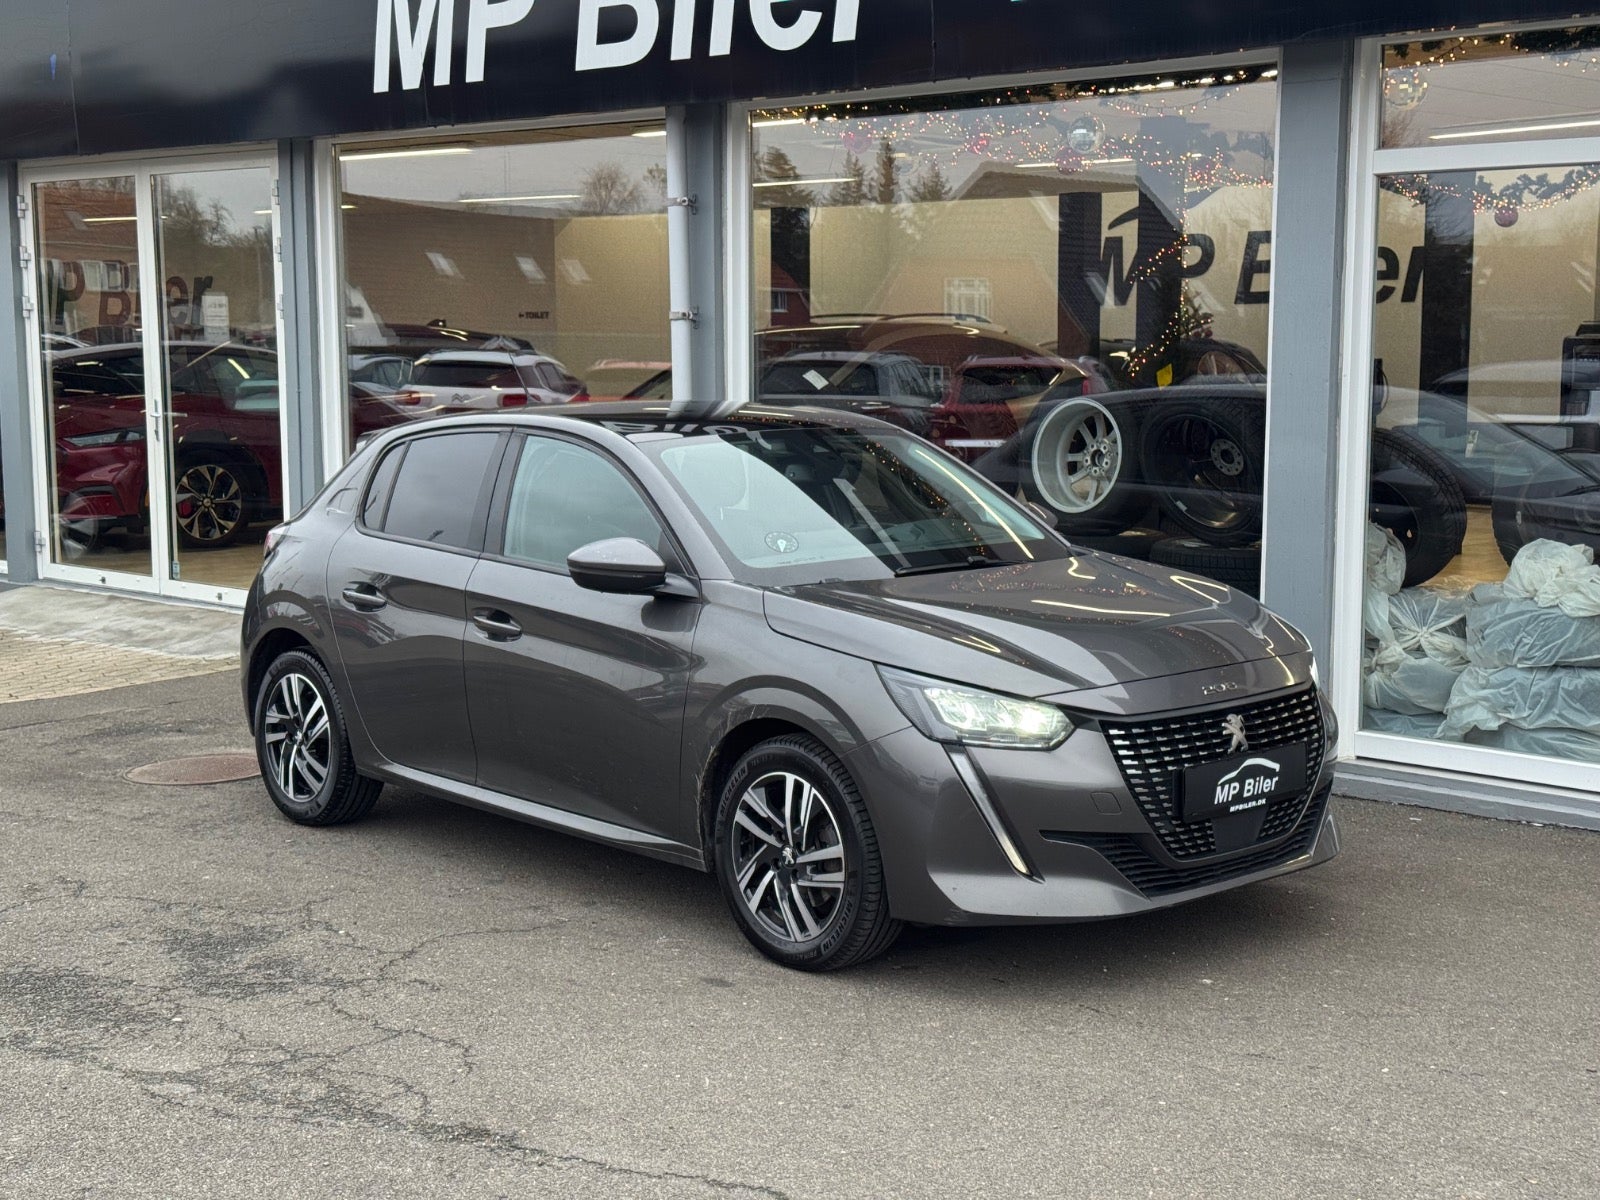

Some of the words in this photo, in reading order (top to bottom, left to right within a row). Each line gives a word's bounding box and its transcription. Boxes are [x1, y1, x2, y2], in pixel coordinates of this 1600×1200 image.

[373, 0, 535, 93] MP
[98, 259, 213, 327] Ber
[525, 311, 549, 320] TOILET
[720, 766, 747, 817] MICHELIN
[1214, 782, 1240, 805] MP
[1243, 775, 1279, 798] Biler
[1229, 798, 1267, 813] MPBILER.DK
[822, 900, 853, 952] MICHELIN
